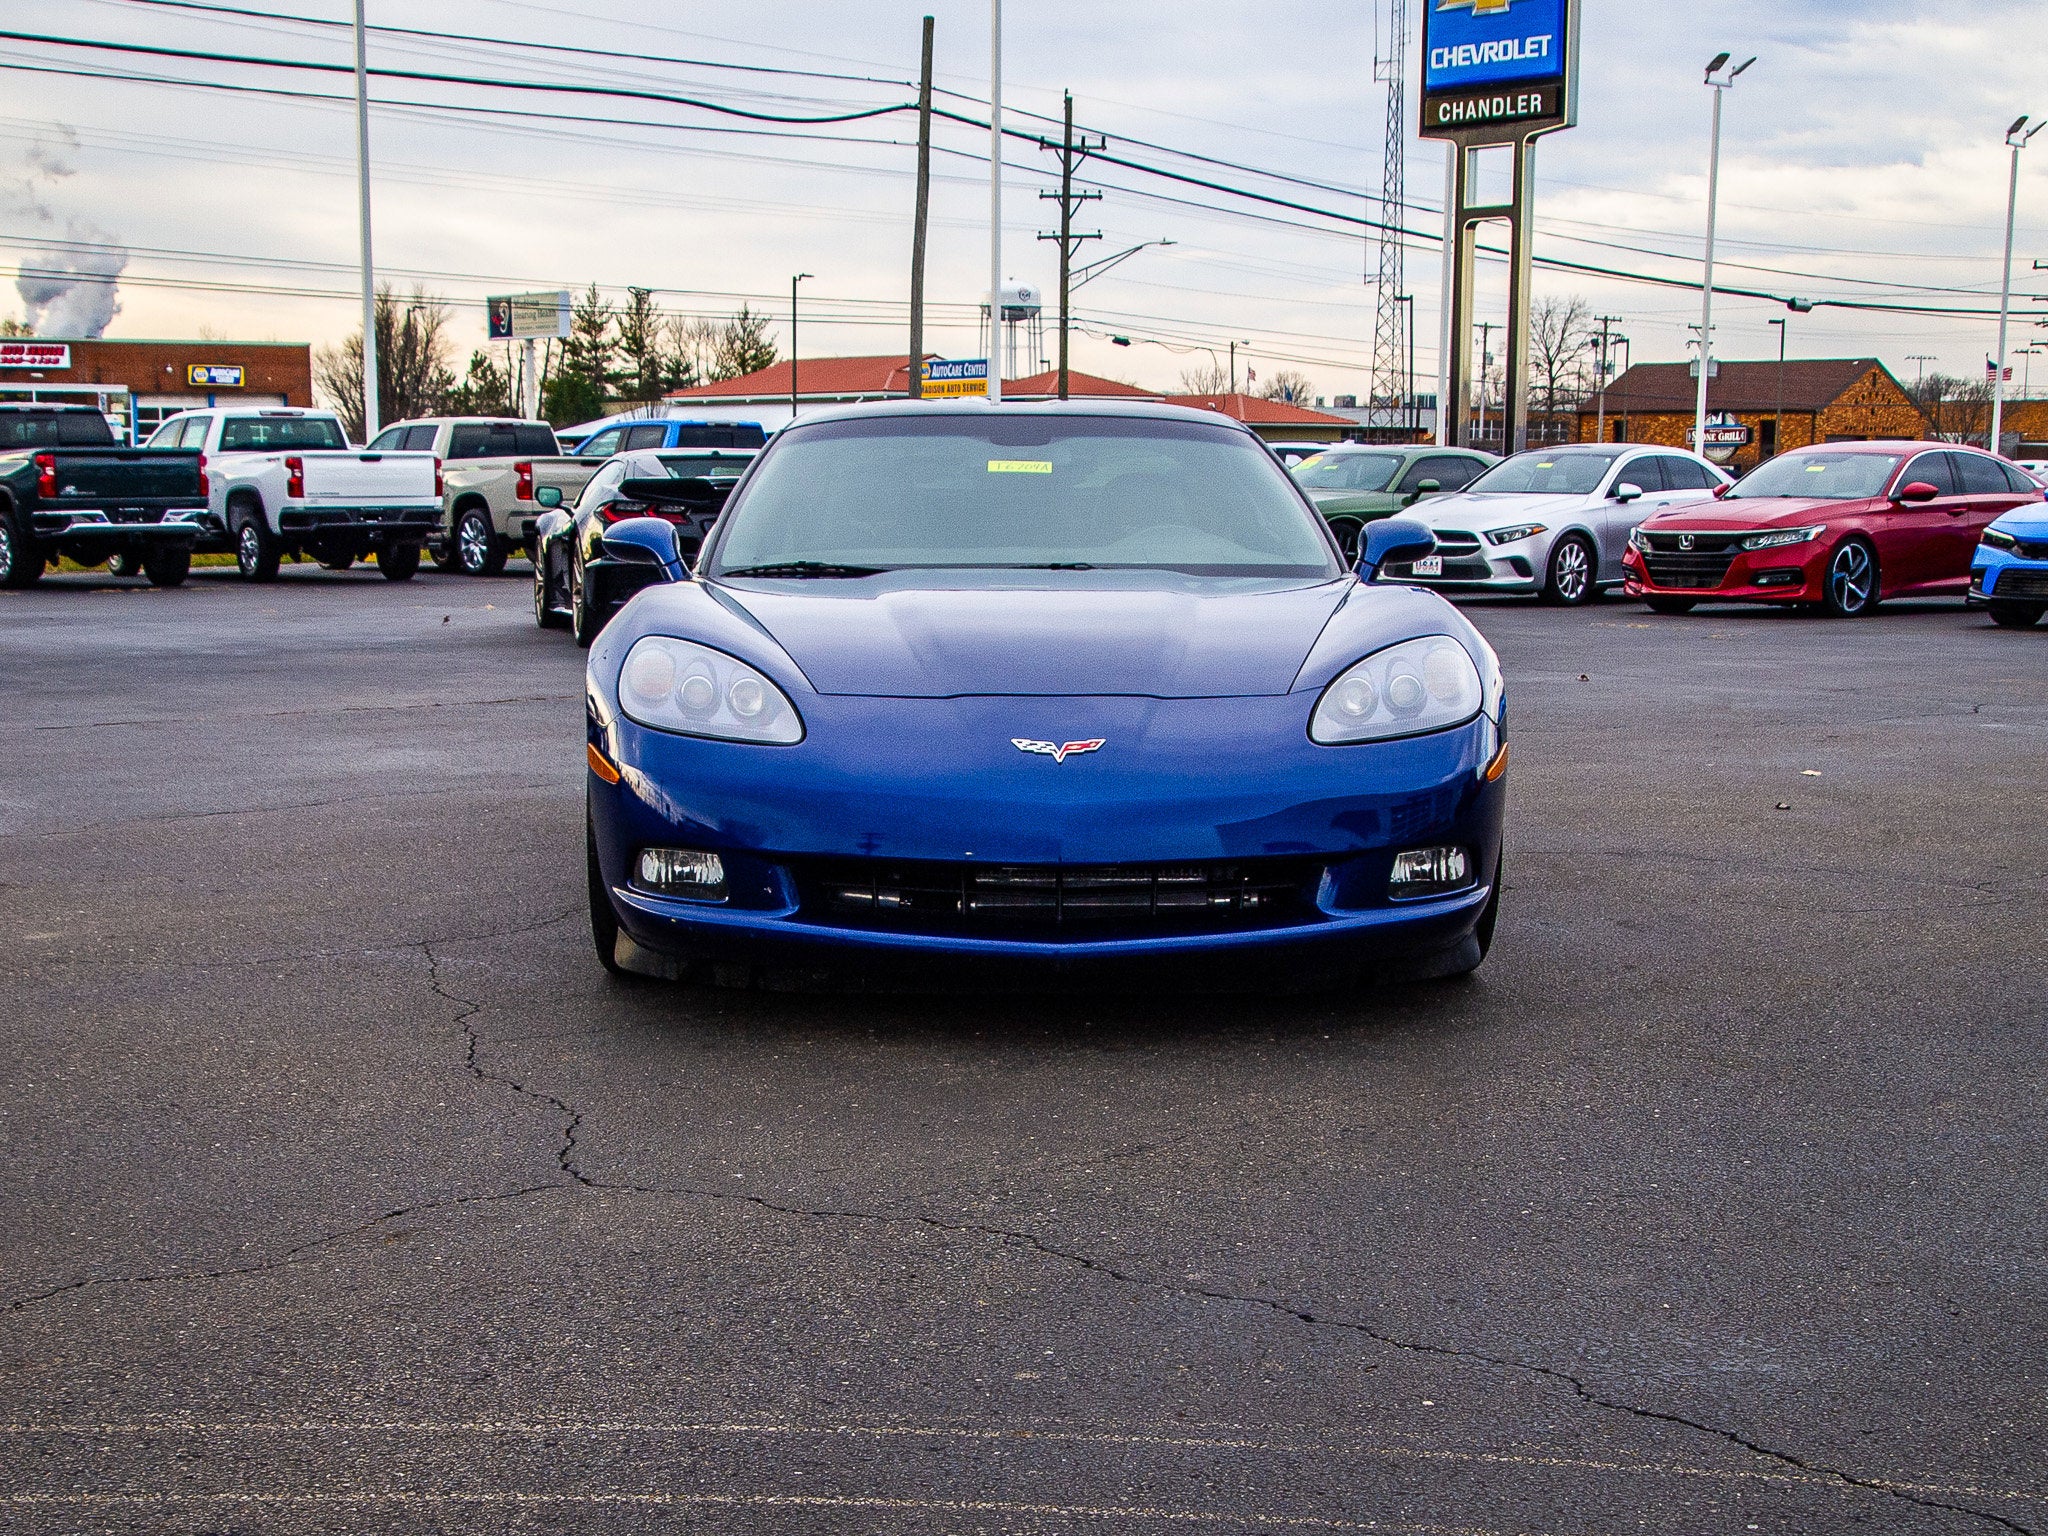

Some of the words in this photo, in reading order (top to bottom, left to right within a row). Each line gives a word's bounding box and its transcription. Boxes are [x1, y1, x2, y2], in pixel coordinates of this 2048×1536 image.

[1430, 34, 1552, 69] CHEVROLET
[1439, 93, 1542, 121] CHANDLER
[963, 362, 986, 376] CENTER
[962, 382, 986, 393] SERVICE
